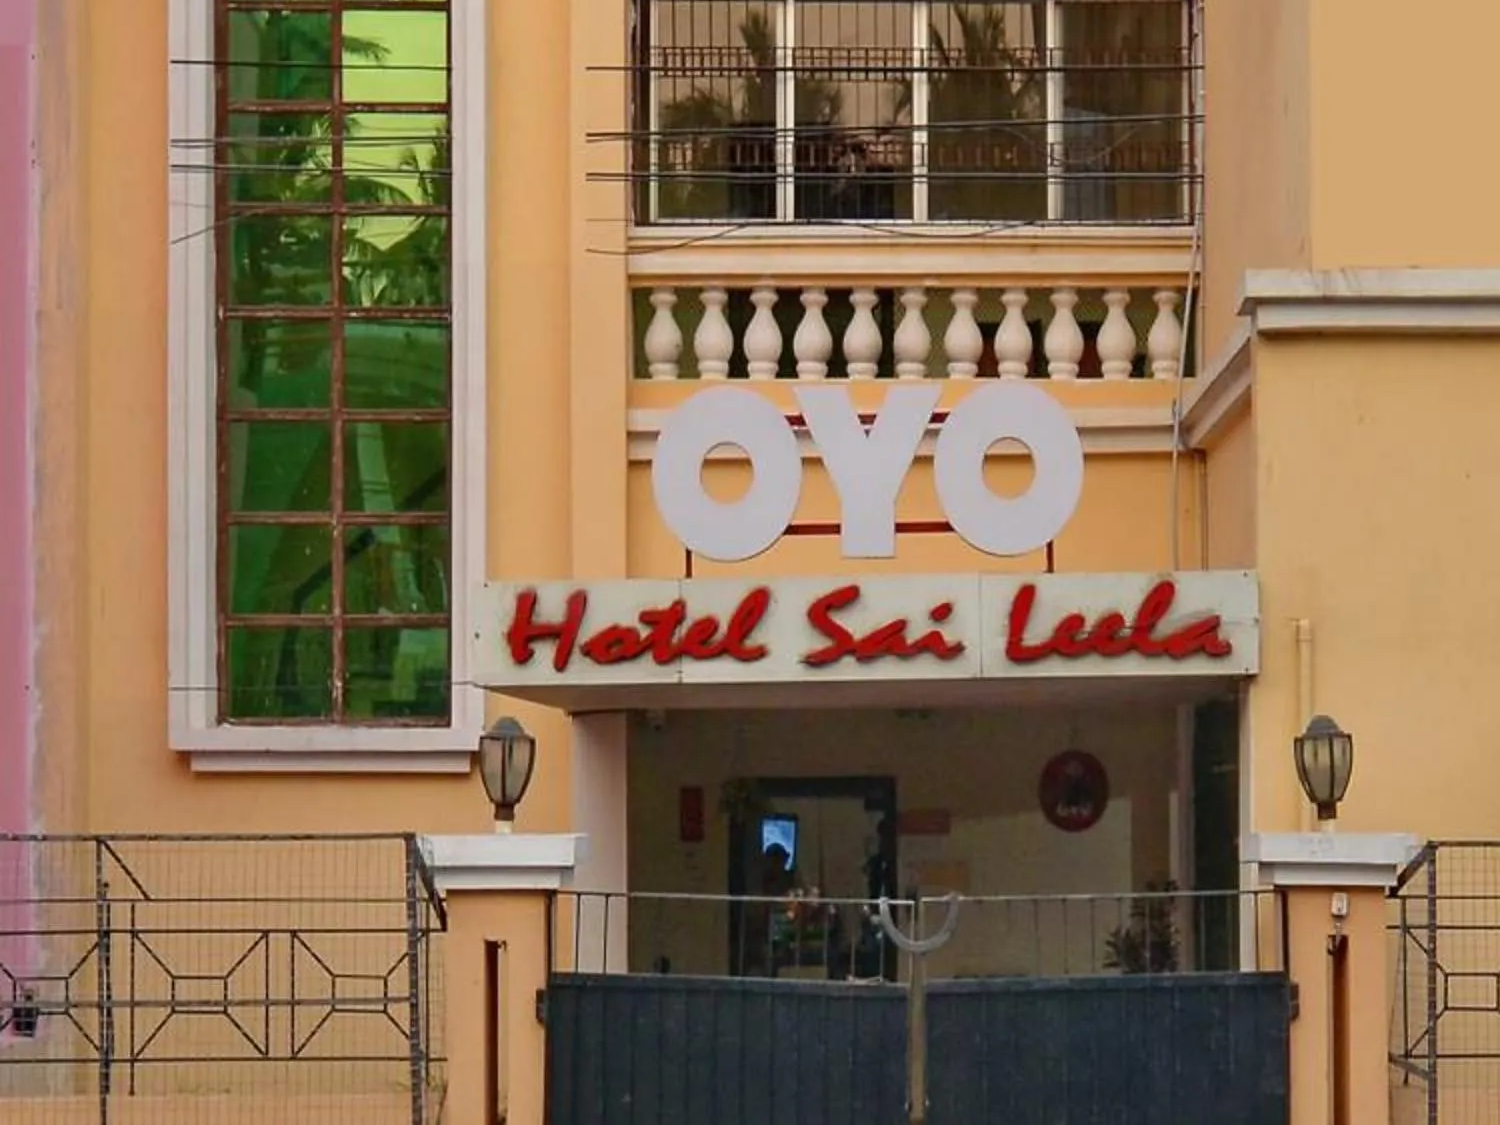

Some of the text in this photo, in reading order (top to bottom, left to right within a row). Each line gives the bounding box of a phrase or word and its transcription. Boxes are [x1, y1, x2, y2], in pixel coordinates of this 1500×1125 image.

[651, 380, 1084, 562] OYO
[506, 579, 1233, 672] Hotel Sai Leela
